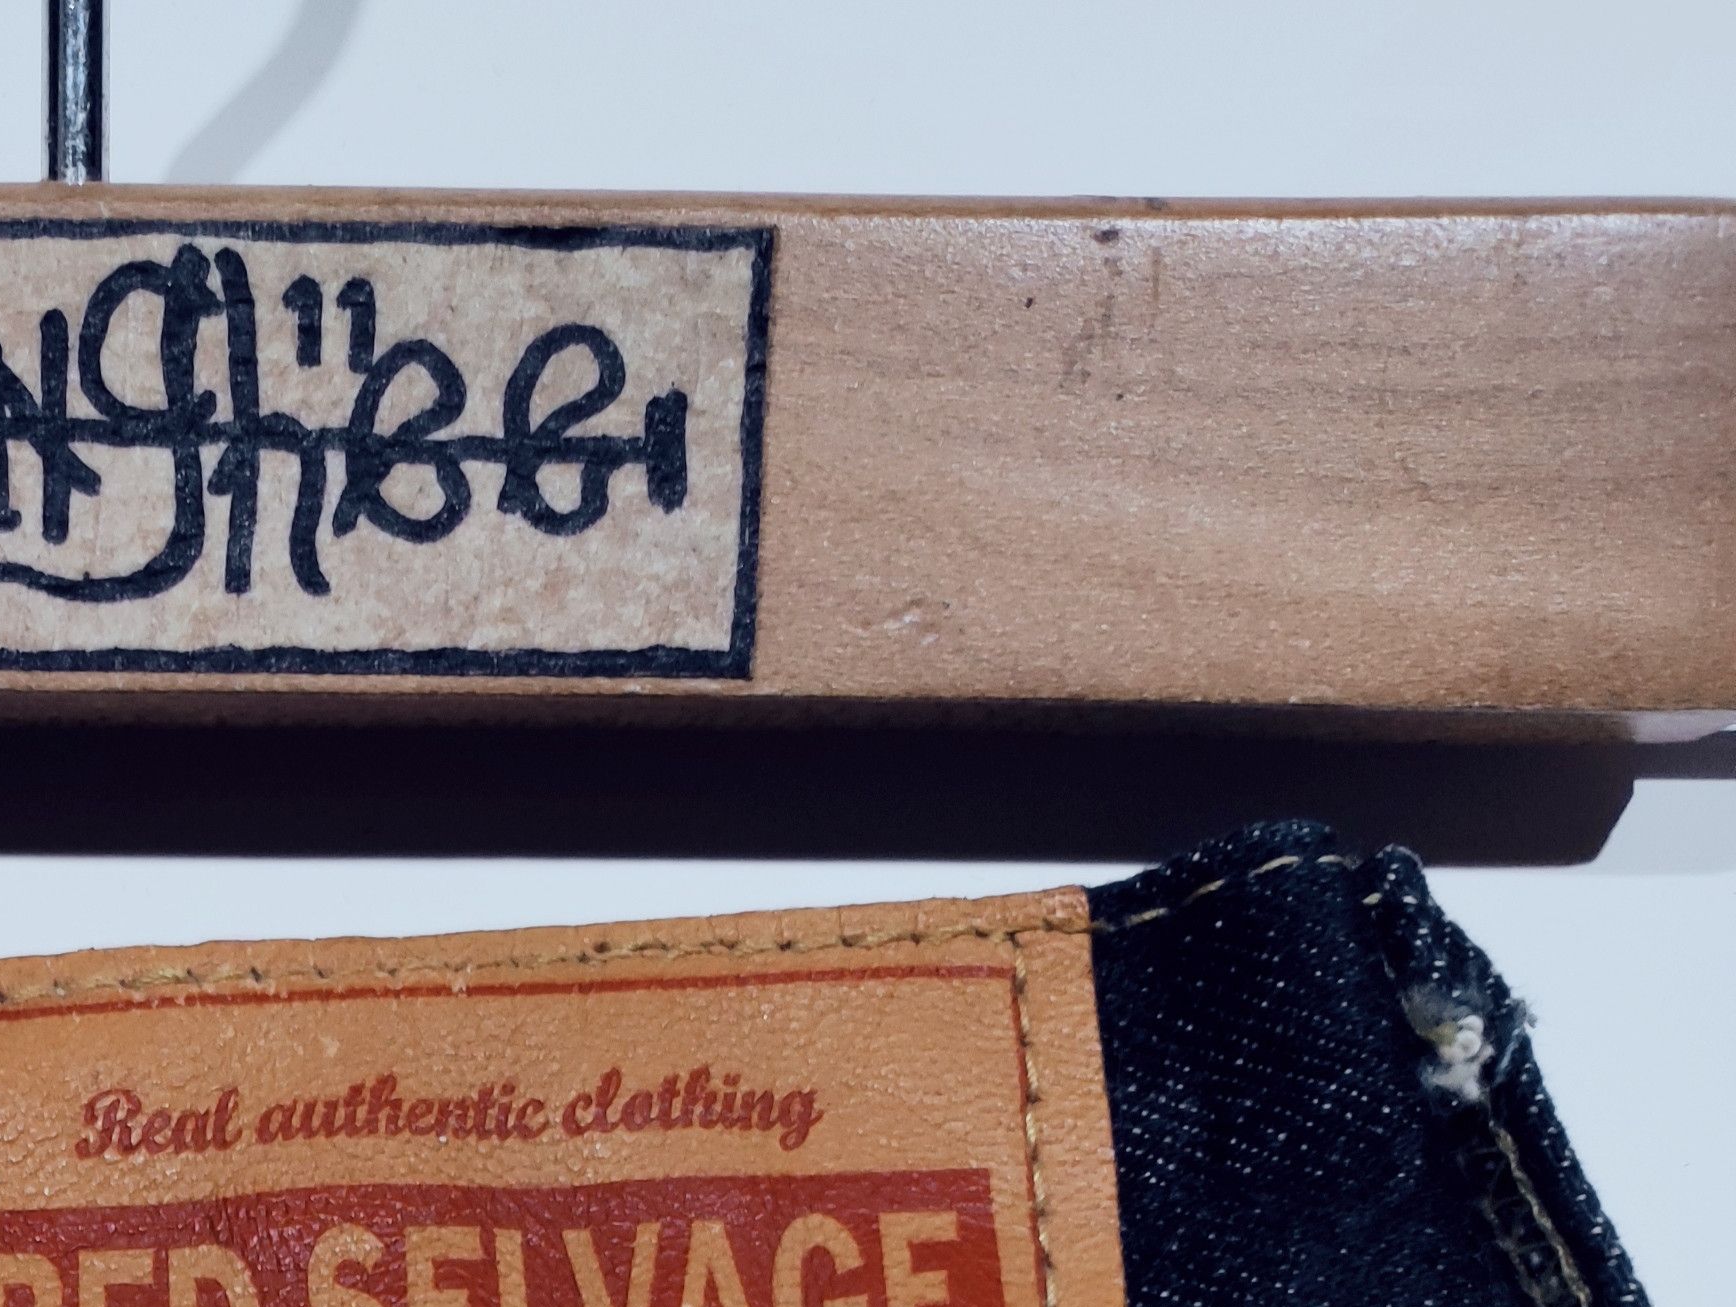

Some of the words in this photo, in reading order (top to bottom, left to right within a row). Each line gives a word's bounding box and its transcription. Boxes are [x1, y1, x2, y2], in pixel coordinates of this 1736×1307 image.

[75, 1086, 242, 1160] Real
[255, 1071, 546, 1144] authentic
[561, 1066, 824, 1152] clothing
